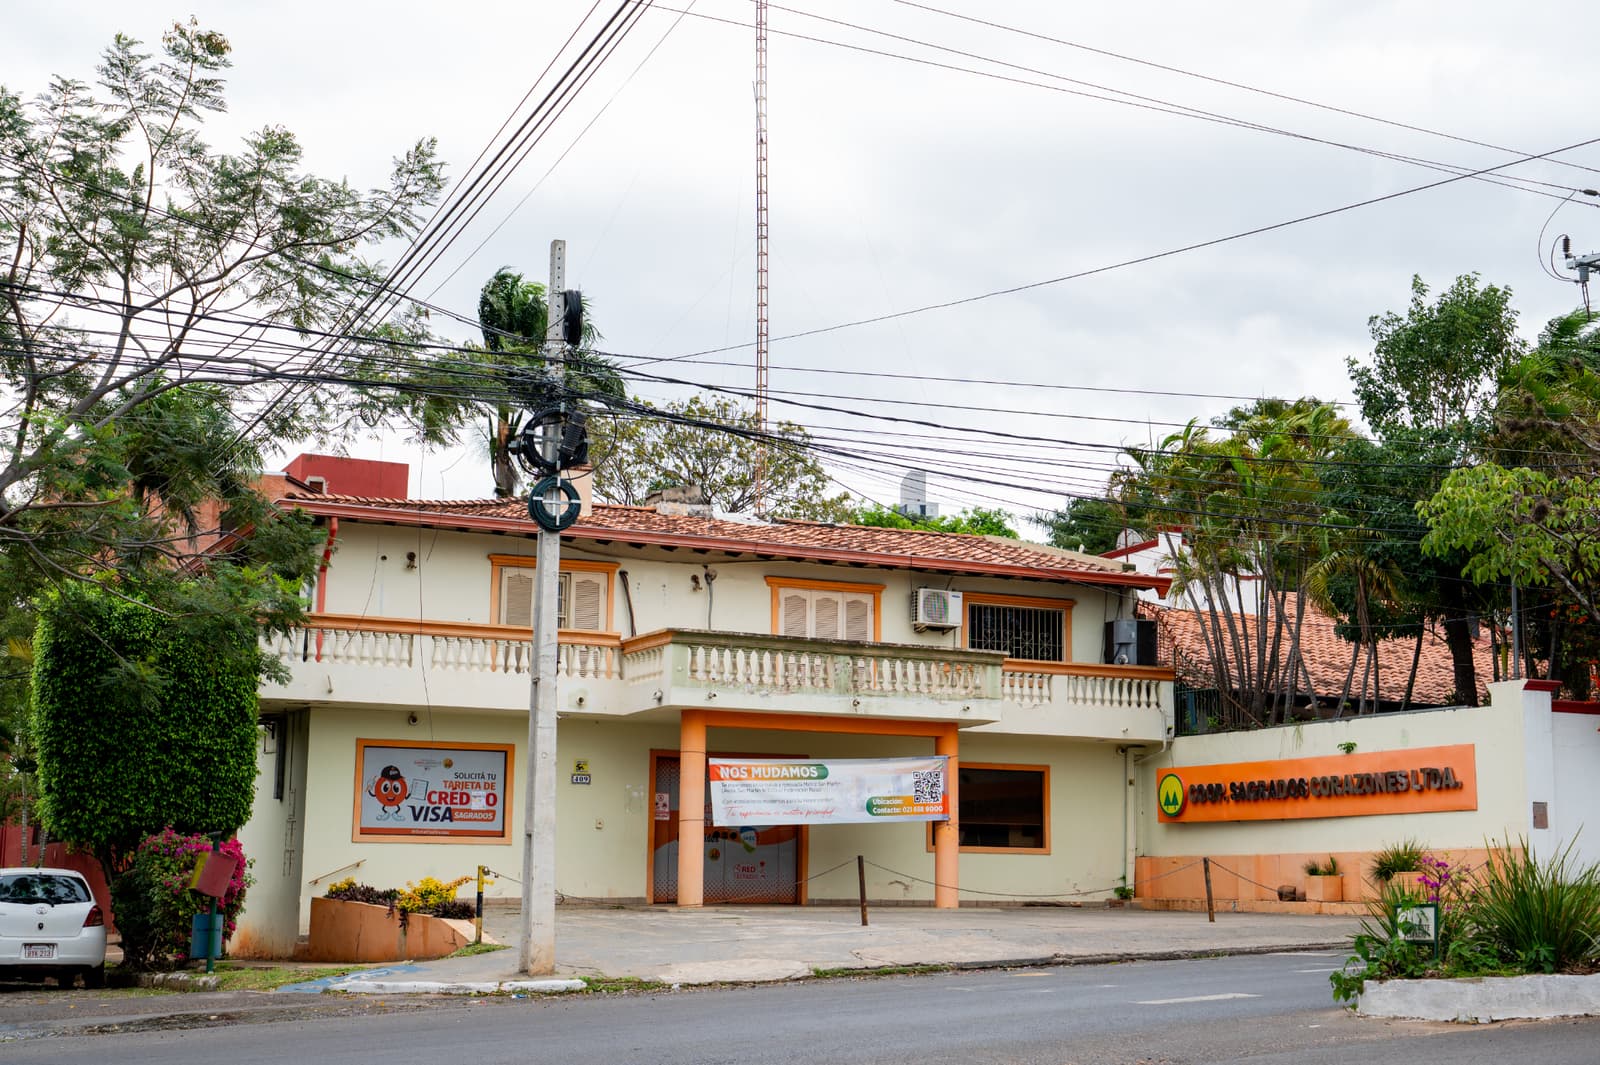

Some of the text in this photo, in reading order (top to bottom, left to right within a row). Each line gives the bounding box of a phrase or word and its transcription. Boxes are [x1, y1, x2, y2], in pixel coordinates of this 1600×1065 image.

[454, 771, 485, 780] SOLICITÁ
[720, 766, 818, 779] NOS MUDAMOS
[443, 780, 497, 790] TARJETA DE
[1229, 778, 1309, 802] SAGRADOS
[1309, 769, 1409, 797] CORAZONES
[1410, 767, 1463, 792] LTDA.
[427, 790, 498, 807] CREDO
[407, 805, 453, 822] VISA
[454, 811, 494, 820] SAGRADOS
